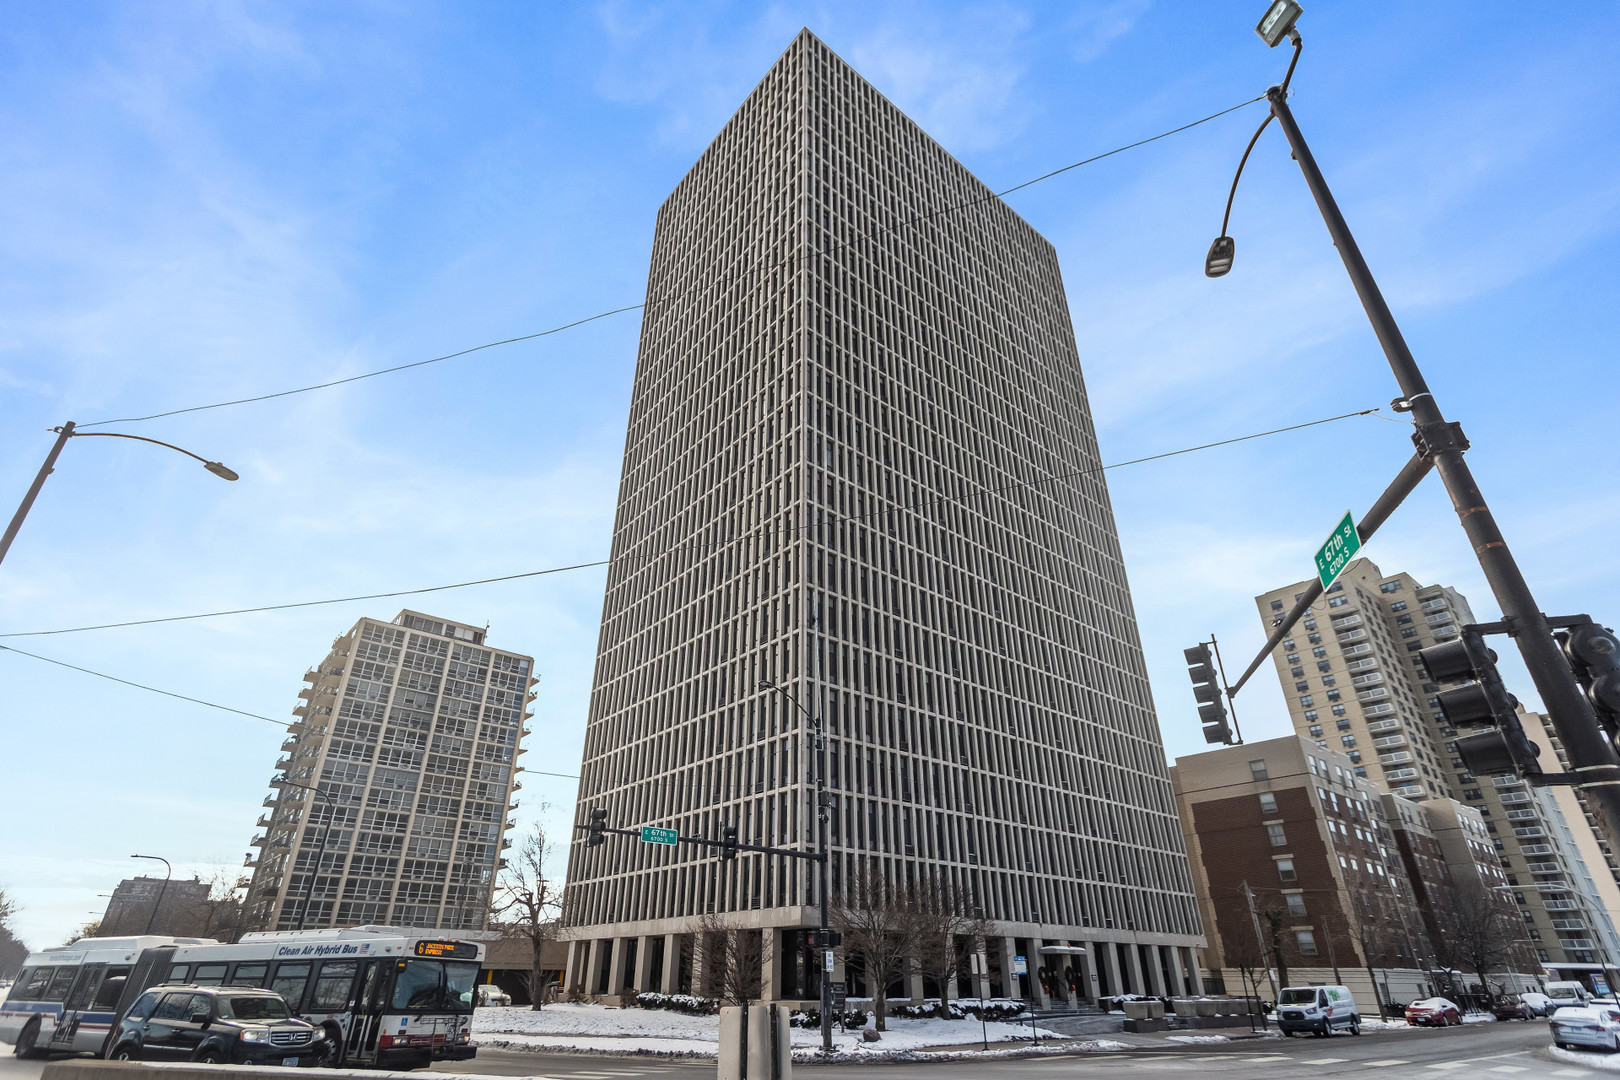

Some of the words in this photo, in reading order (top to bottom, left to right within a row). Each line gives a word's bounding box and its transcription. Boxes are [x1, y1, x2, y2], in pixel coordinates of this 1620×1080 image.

[1319, 559, 1325, 570] E
[1324, 533, 1344, 562] 67th
[1344, 525, 1352, 538] St
[1329, 553, 1344, 576] 6700
[1344, 546, 1350, 558] S
[278, 946, 300, 956] Clean
[301, 946, 314, 955] Air
[314, 944, 342, 956] Hybrid
[342, 944, 358, 954] Bus
[418, 942, 424, 954] 6
